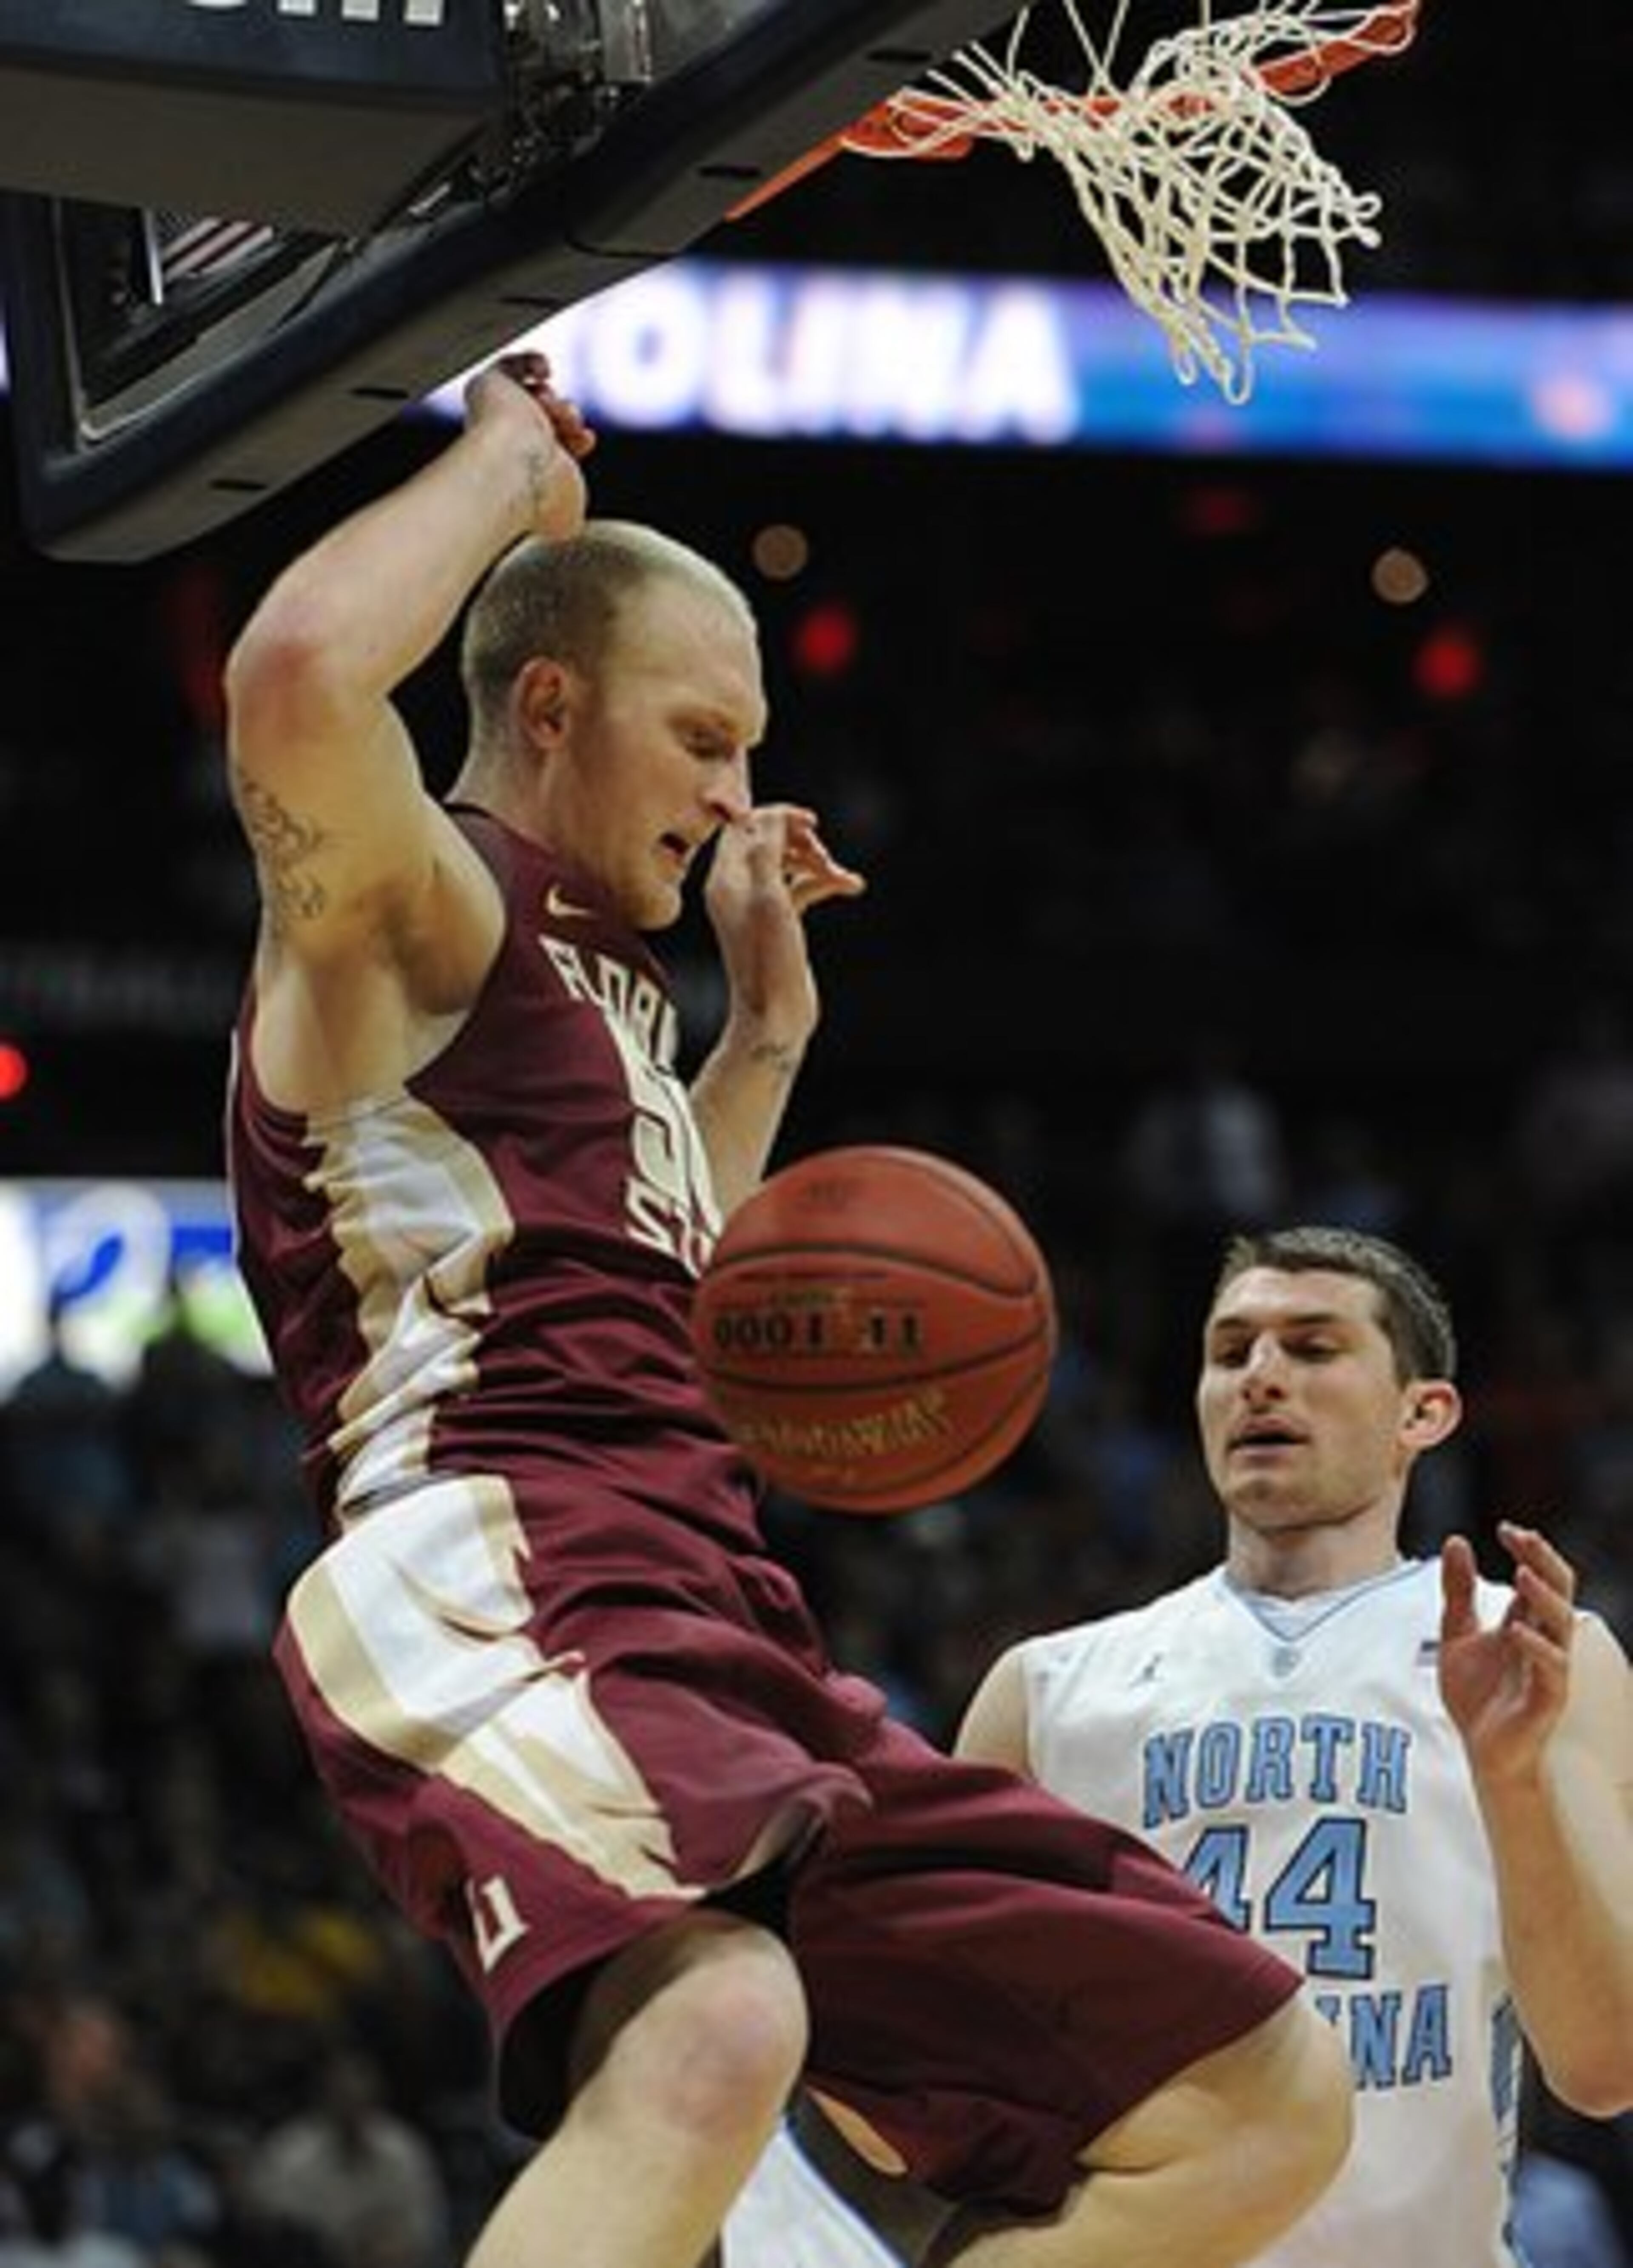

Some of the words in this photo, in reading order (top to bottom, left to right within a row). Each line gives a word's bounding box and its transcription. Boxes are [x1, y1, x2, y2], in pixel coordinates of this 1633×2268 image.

[1143, 1713, 1411, 1830] NORTH
[1182, 1817, 1377, 1980] 44
[1315, 1983, 1452, 2091] NA
